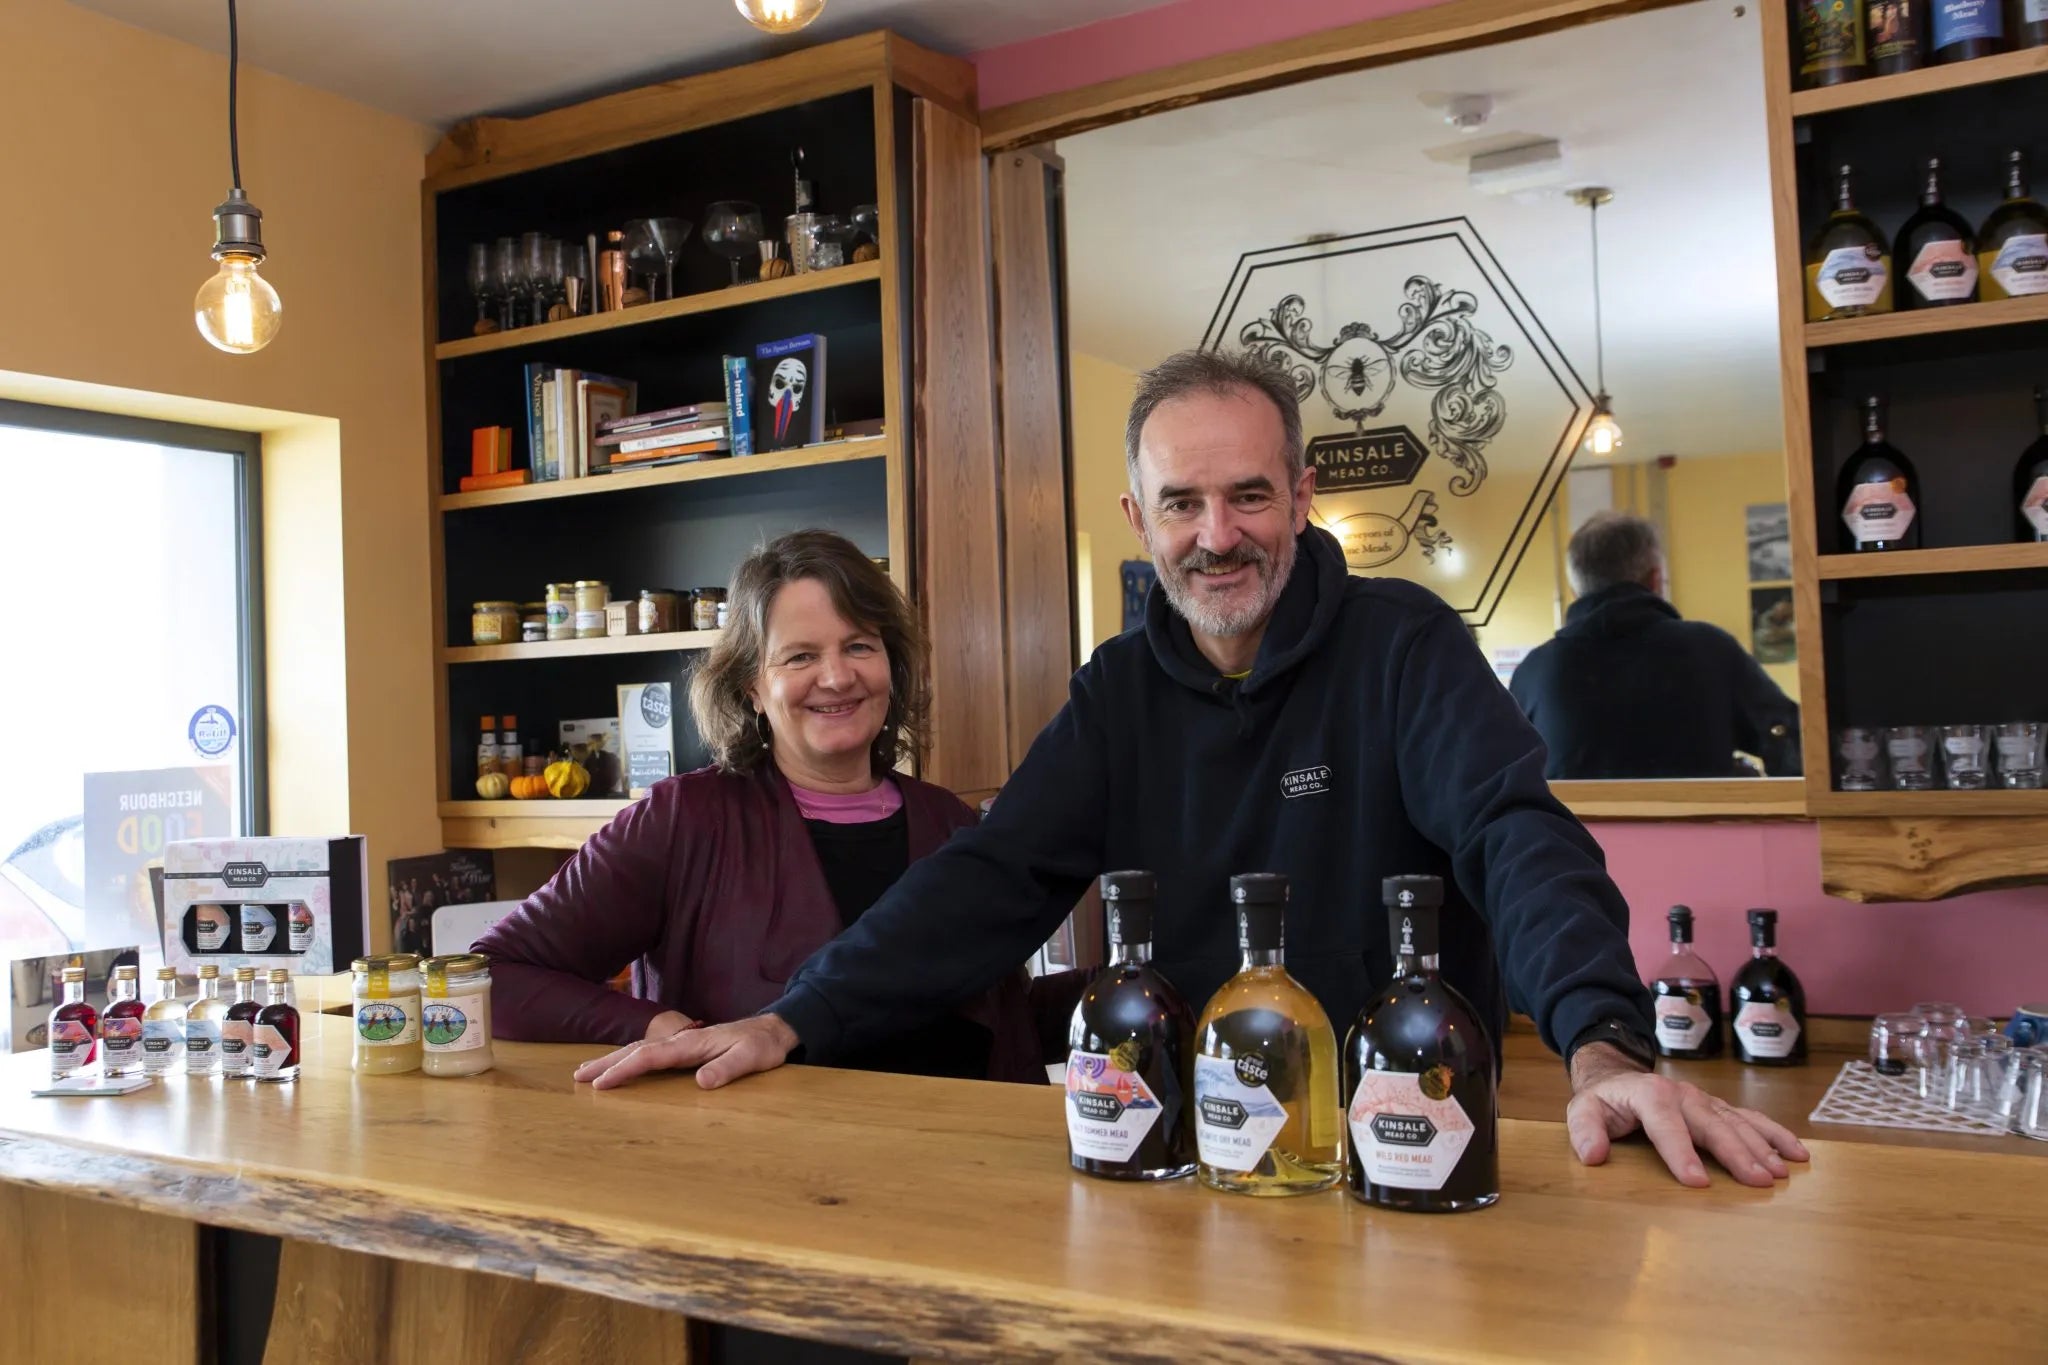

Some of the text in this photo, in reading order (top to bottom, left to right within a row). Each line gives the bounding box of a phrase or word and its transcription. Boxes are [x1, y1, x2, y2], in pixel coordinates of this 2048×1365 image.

[533, 373, 544, 417] VIKINGS
[734, 379, 745, 417] Ireland
[1314, 443, 1405, 465] KINSALE
[1328, 464, 1393, 479] MEAD CO.
[1383, 527, 1394, 537] of
[1361, 542, 1393, 554] Meads
[642, 696, 671, 717] taste
[1284, 769, 1328, 787] KINSALE
[1289, 782, 1323, 793] MEAD CO.
[227, 867, 262, 876] KINSALE
[1237, 1059, 1268, 1079] taste
[1079, 1096, 1116, 1109] KINSALE
[1204, 1102, 1239, 1116] KINSALE
[1082, 1106, 1099, 1115] MEAD
[1207, 1112, 1222, 1121] MEAD
[1084, 1126, 1108, 1136] SUMMER
[1110, 1128, 1129, 1139] MEAD
[1378, 1119, 1427, 1133] KINSALE
[1384, 1130, 1405, 1139] MEAD
[1232, 1136, 1251, 1147] MEAD
[1394, 1152, 1409, 1161] RED
[1411, 1153, 1433, 1163] MEAD
